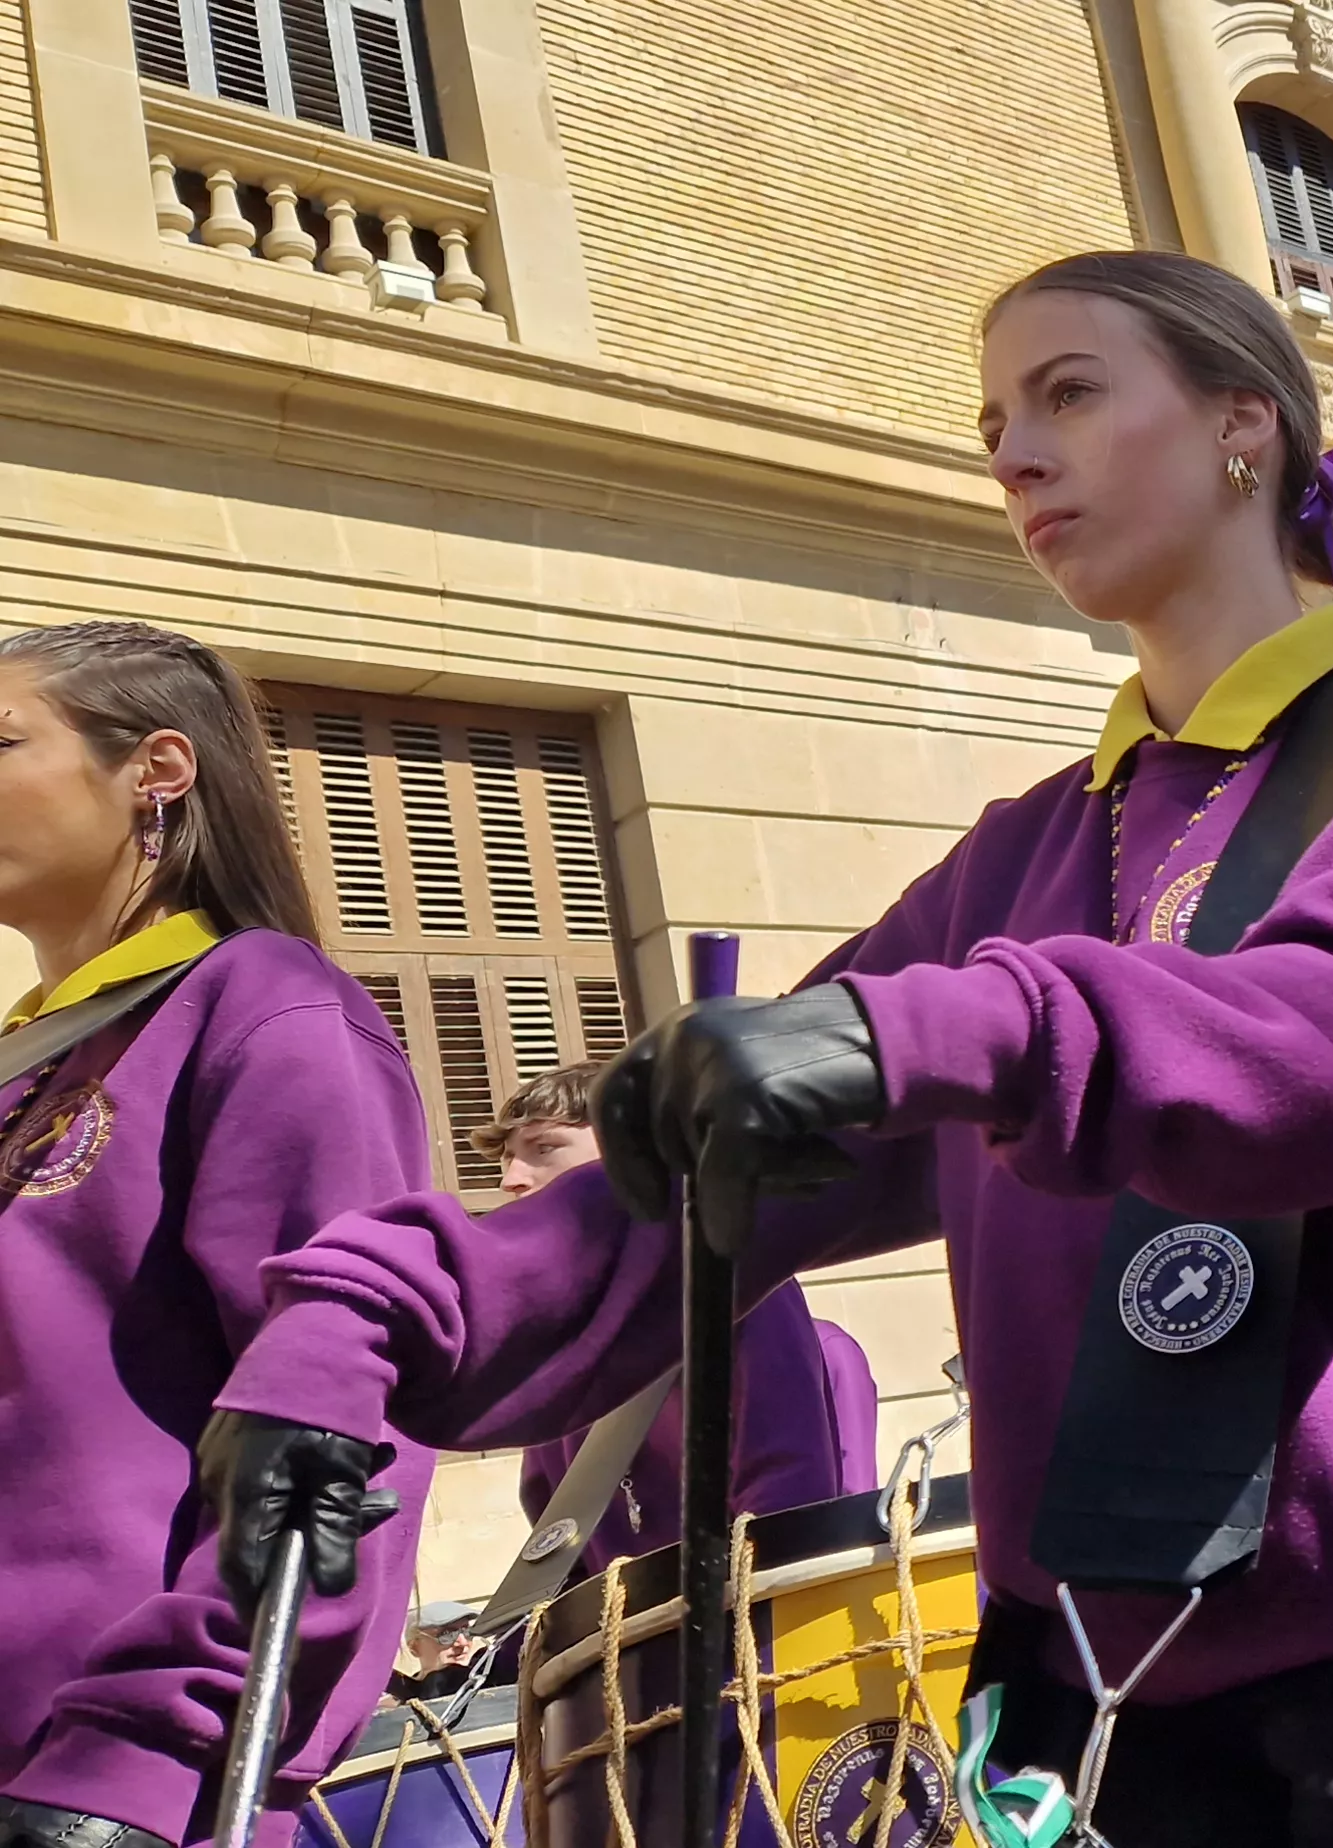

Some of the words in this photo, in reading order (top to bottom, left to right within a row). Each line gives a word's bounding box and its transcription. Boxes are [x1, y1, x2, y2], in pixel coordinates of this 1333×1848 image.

[1154, 1235, 1171, 1250] DE
[1173, 1229, 1223, 1241] NUESTRO
[1223, 1237, 1248, 1268] PADRE
[813, 1756, 833, 1781] DE
[829, 1725, 896, 1761] NUESTRO
